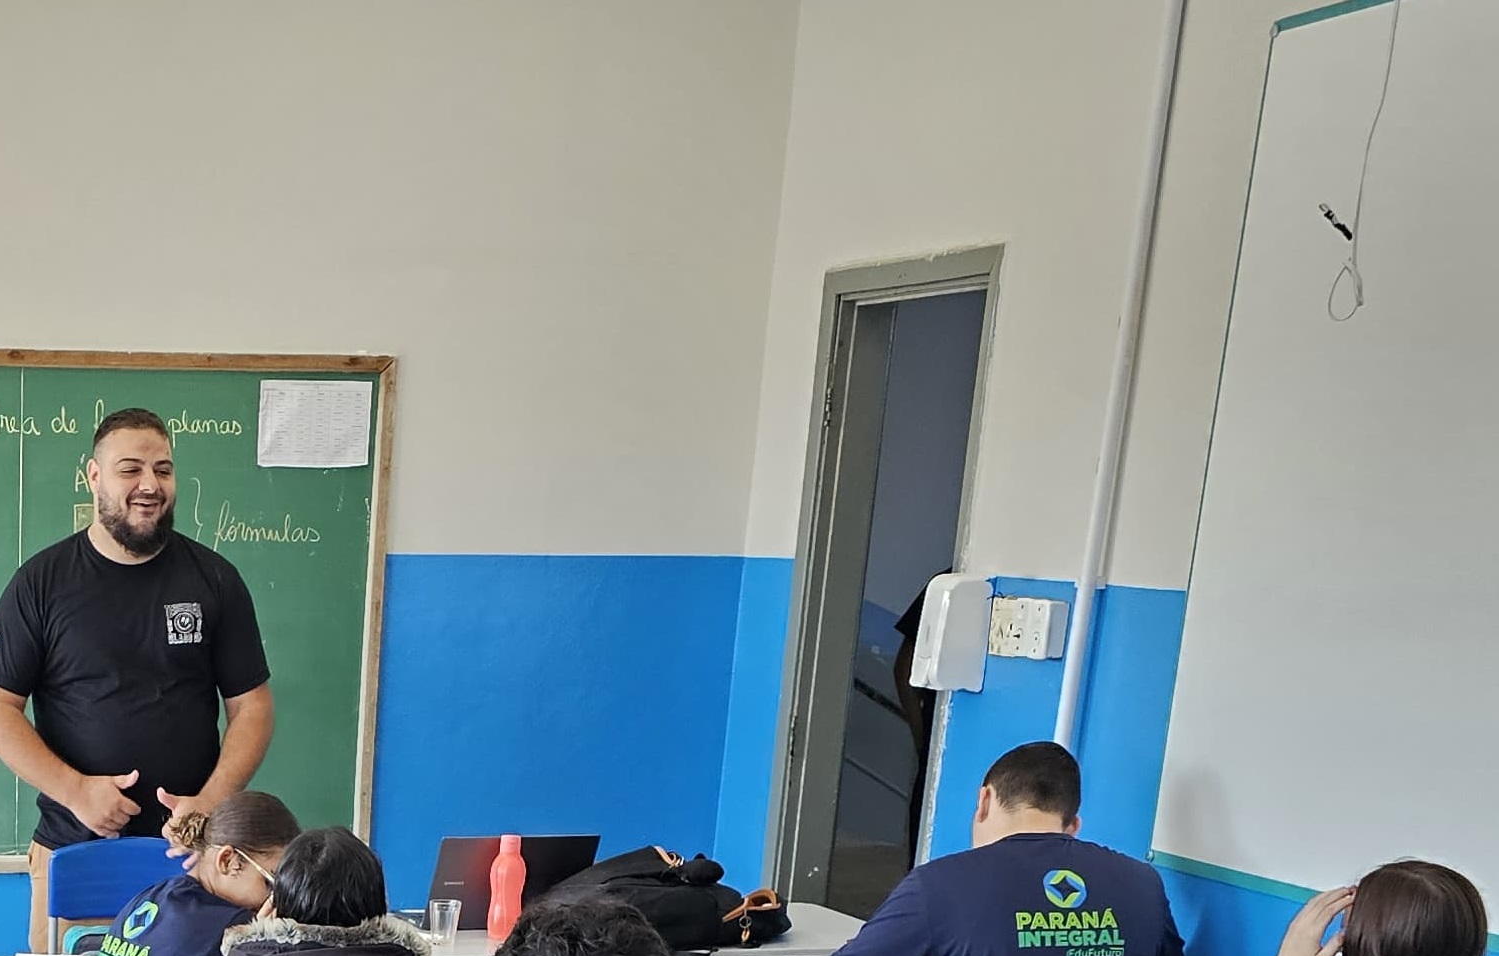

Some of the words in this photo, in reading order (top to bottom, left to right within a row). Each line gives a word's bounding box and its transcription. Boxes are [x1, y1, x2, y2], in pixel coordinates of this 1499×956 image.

[51, 406, 78, 434] de
[168, 408, 242, 448] planas
[214, 501, 322, 551] fórmulas
[1015, 907, 1118, 931] PARANÁ
[1017, 928, 1125, 948] INTEGRAL
